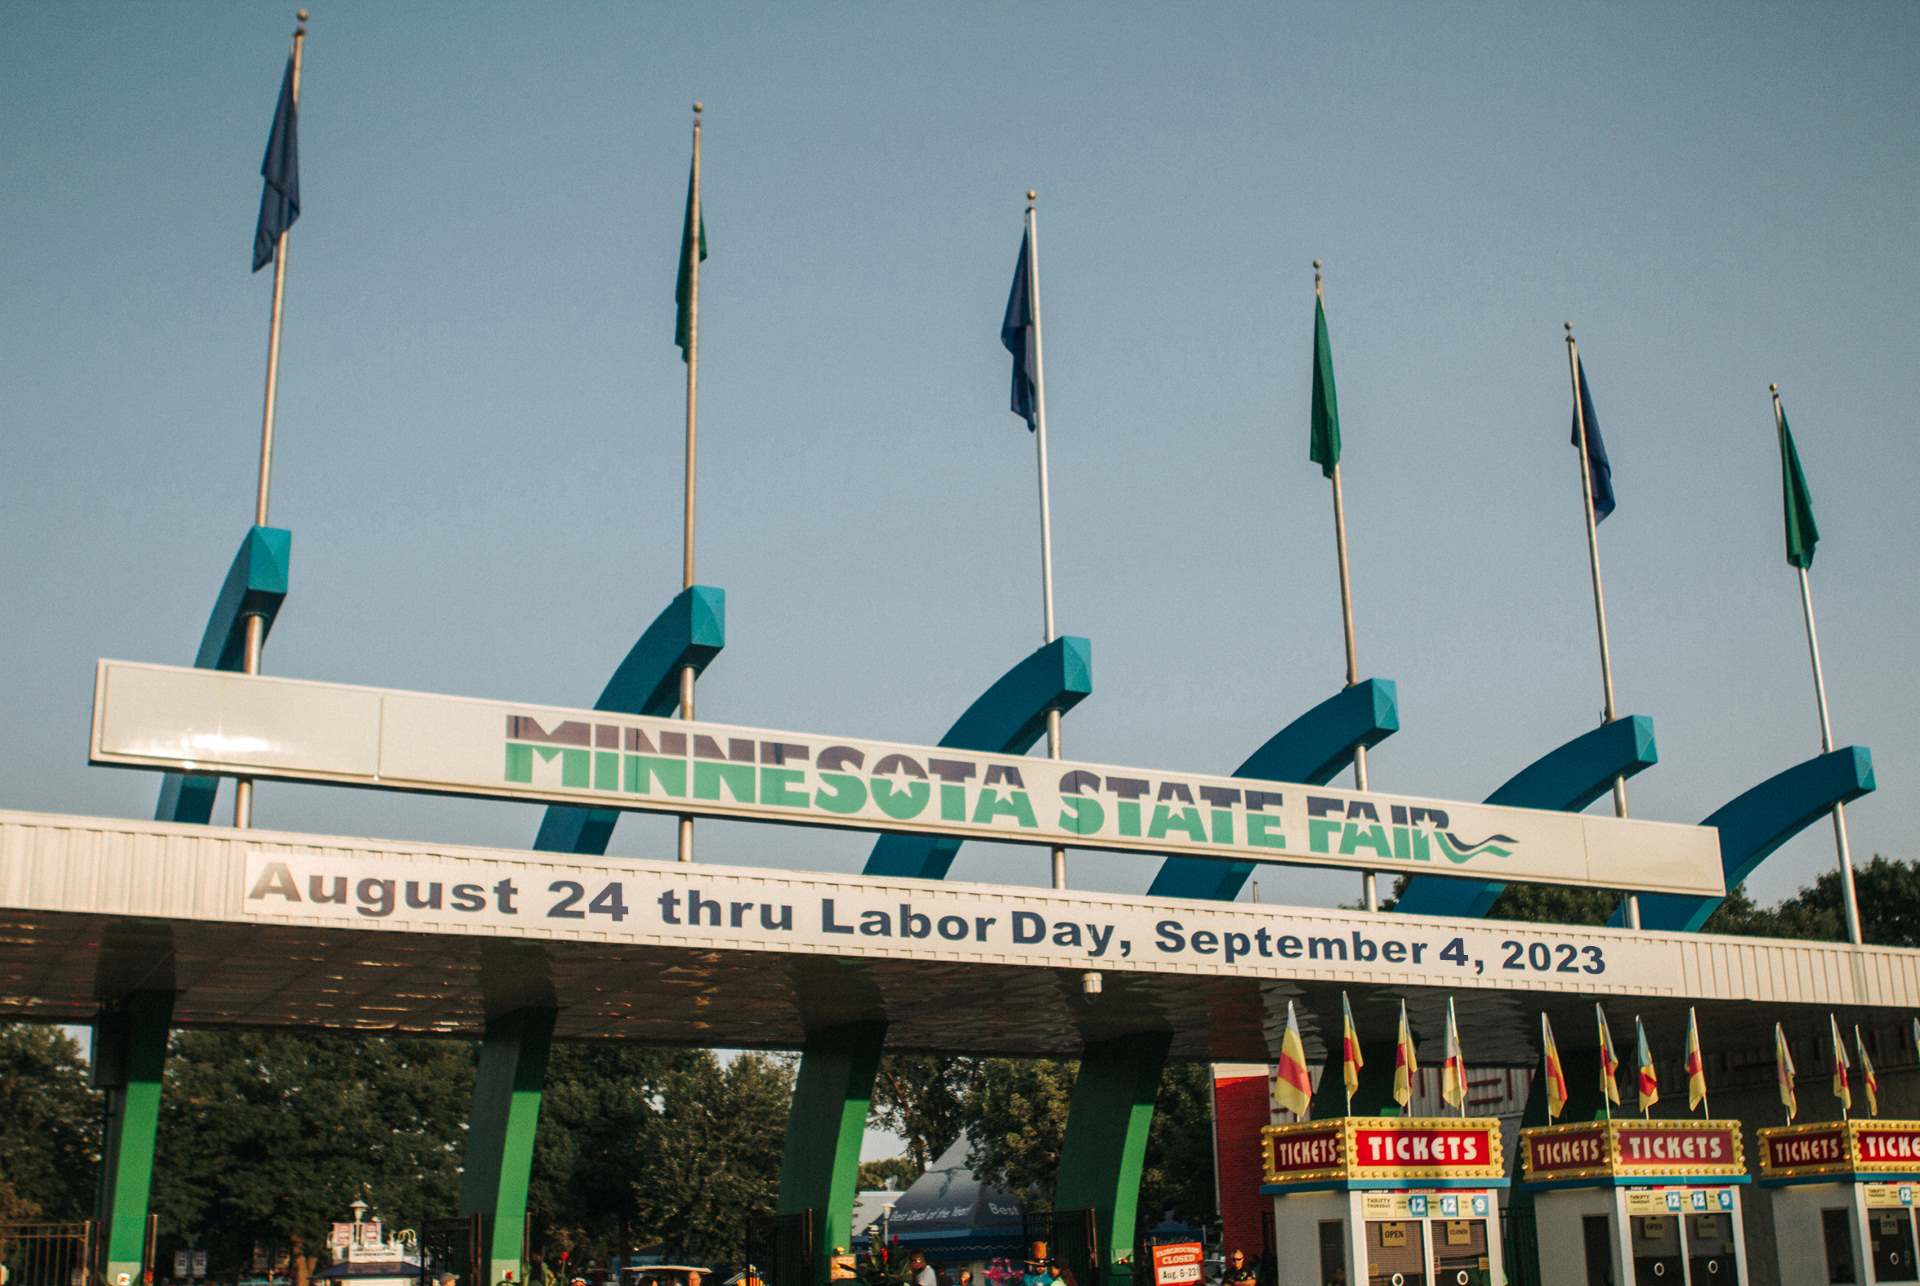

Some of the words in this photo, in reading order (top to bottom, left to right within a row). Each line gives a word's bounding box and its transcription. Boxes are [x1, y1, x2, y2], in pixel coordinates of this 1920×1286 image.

[505, 714, 1039, 829] MINNESOTA
[1058, 769, 1288, 849] STATE
[1306, 794, 1519, 864] FAIR
[248, 861, 519, 918] August
[547, 880, 629, 922] 24
[658, 887, 793, 932] thru
[821, 898, 996, 943] Labor
[1011, 910, 1132, 958] Day,
[1155, 918, 1427, 964] September
[1438, 937, 1485, 975] 4,
[1501, 939, 1607, 975] 2023
[1279, 1137, 1337, 1166] TICKETS
[1368, 1136, 1478, 1161] TICKETS
[1537, 1138, 1600, 1164] TICKETS
[1629, 1136, 1723, 1159] TICKETS
[1775, 1137, 1840, 1164] TICKETS
[988, 1202, 1020, 1216] Best
[1384, 1230, 1404, 1239] OPEN
[1162, 1254, 1196, 1264] CLOSED
